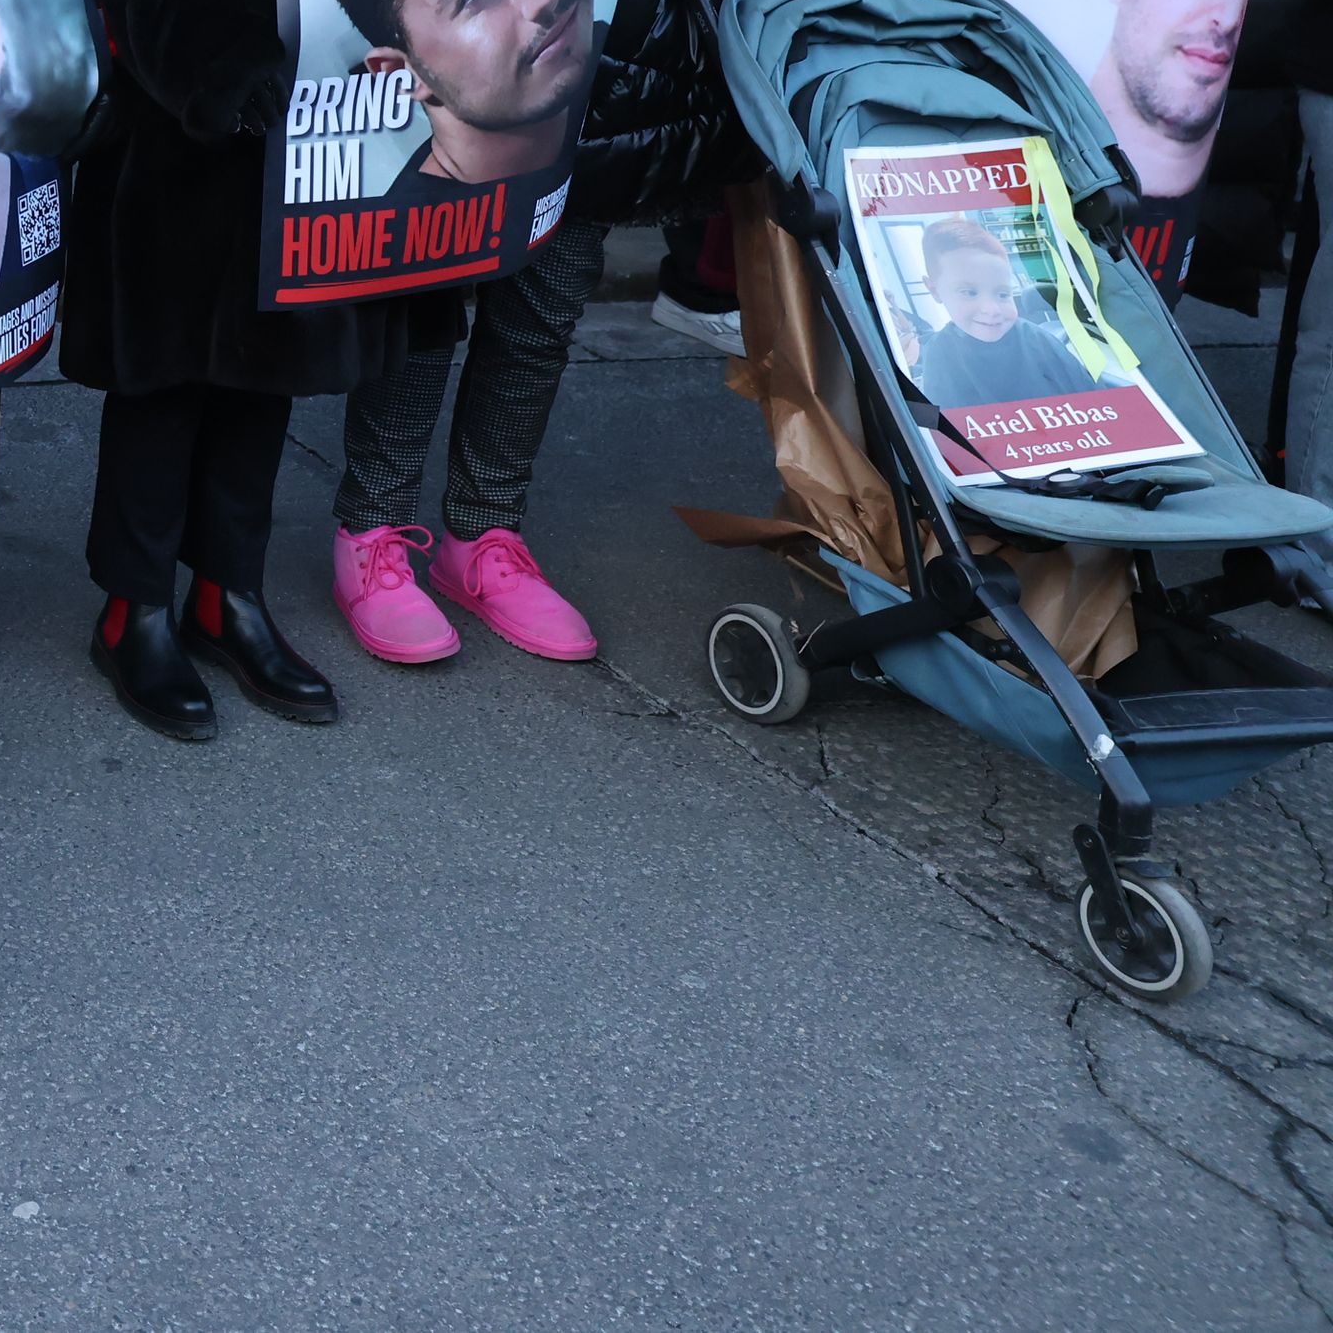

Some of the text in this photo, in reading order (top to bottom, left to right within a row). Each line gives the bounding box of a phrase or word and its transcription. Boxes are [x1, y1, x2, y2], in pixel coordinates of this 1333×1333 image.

[286, 68, 413, 137] BRING
[284, 139, 360, 205] HIM
[856, 162, 1031, 199] KIDNAPPED
[281, 183, 506, 277] HOME NOW!
[21, 299, 35, 323] AND
[964, 401, 1119, 440] Ariel Bibas
[1005, 430, 1112, 463] 4 years old
